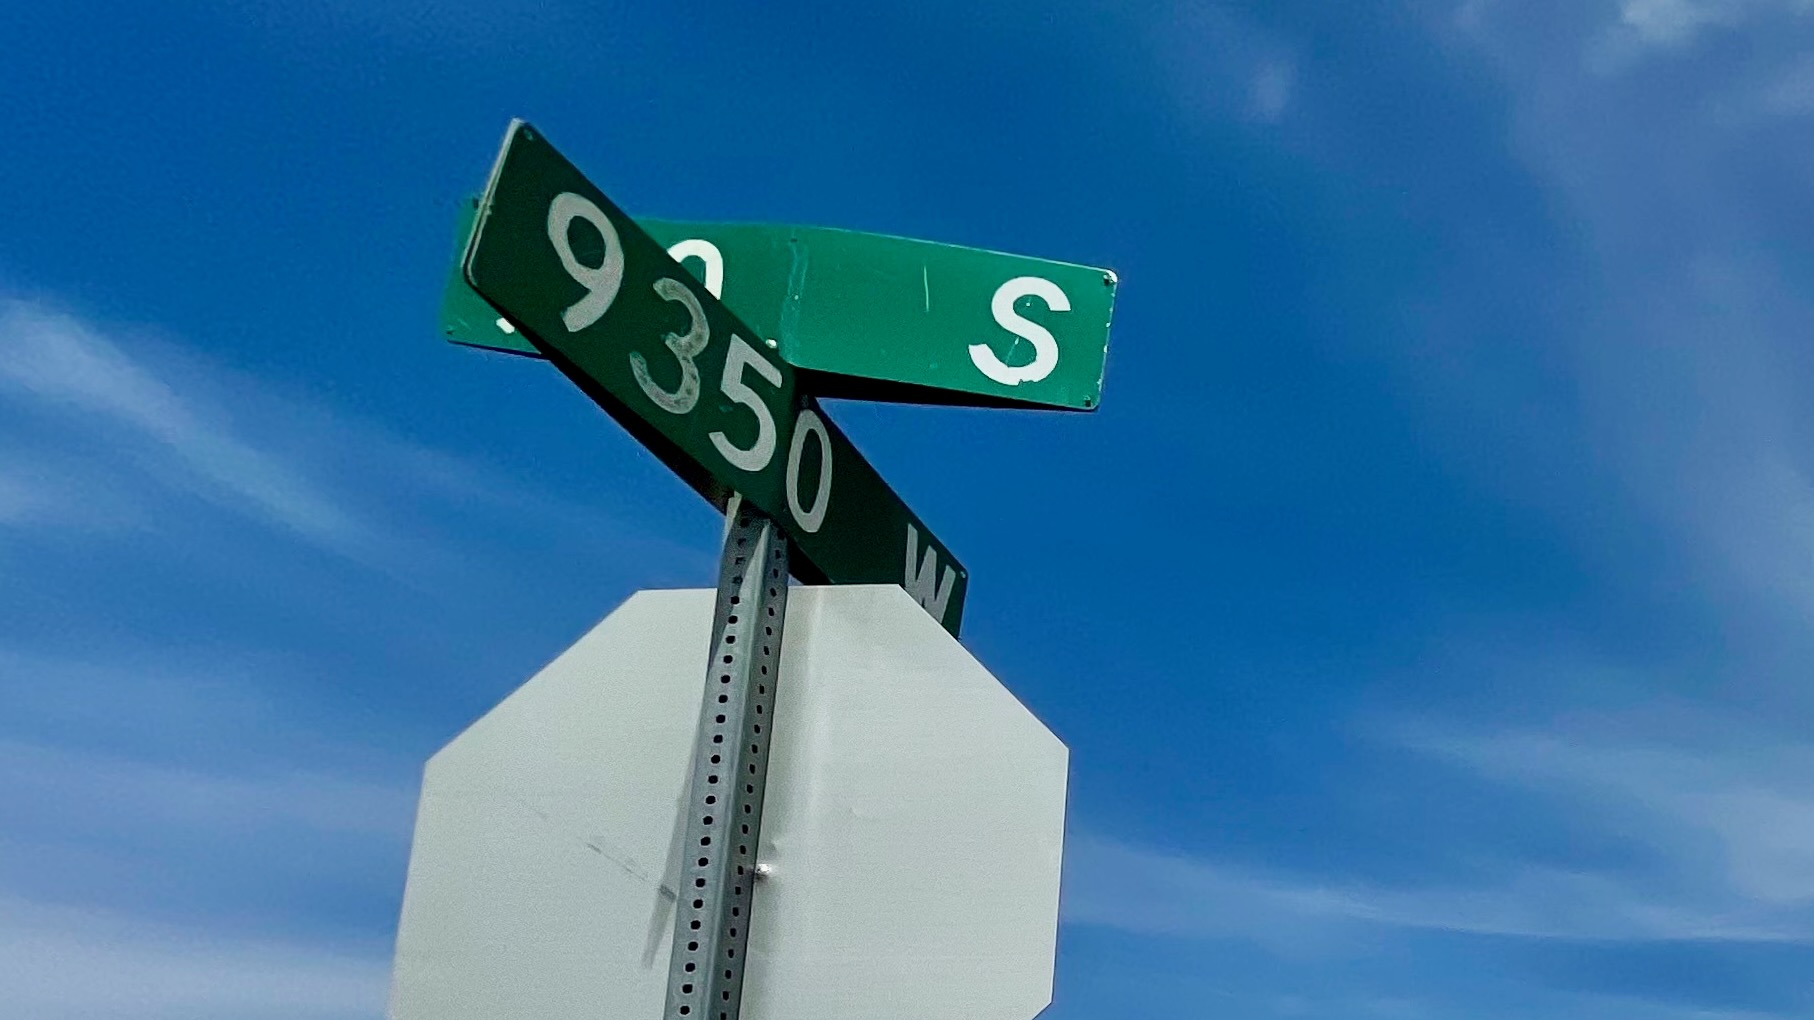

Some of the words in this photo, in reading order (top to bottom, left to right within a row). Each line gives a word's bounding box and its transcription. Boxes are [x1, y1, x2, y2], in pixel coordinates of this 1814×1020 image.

[547, 192, 833, 533] 9350
[904, 526, 956, 624] W
[968, 277, 1071, 387] S
